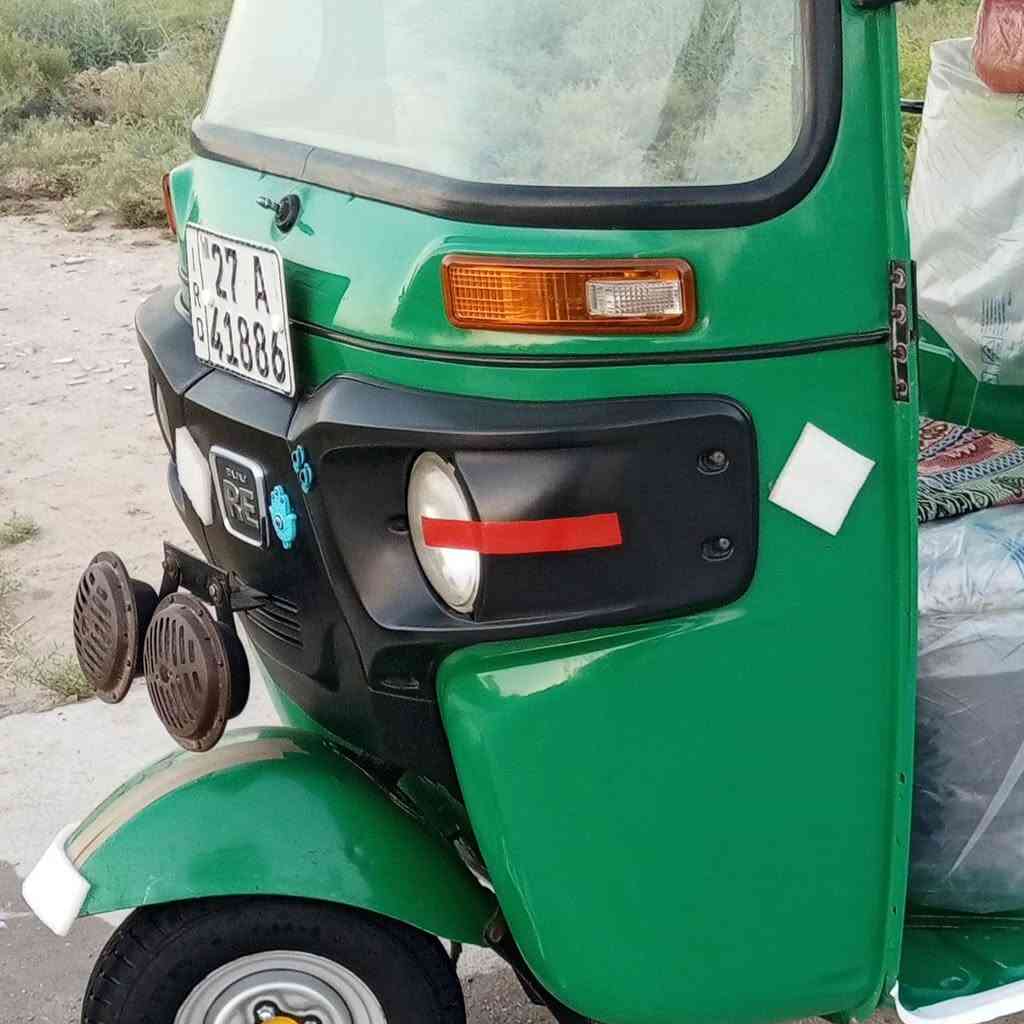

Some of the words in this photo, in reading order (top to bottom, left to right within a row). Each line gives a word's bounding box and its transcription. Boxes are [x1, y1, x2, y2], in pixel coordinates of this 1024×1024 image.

[211, 243, 238, 304] 27
[253, 255, 270, 314] A
[210, 306, 287, 384] 41886
